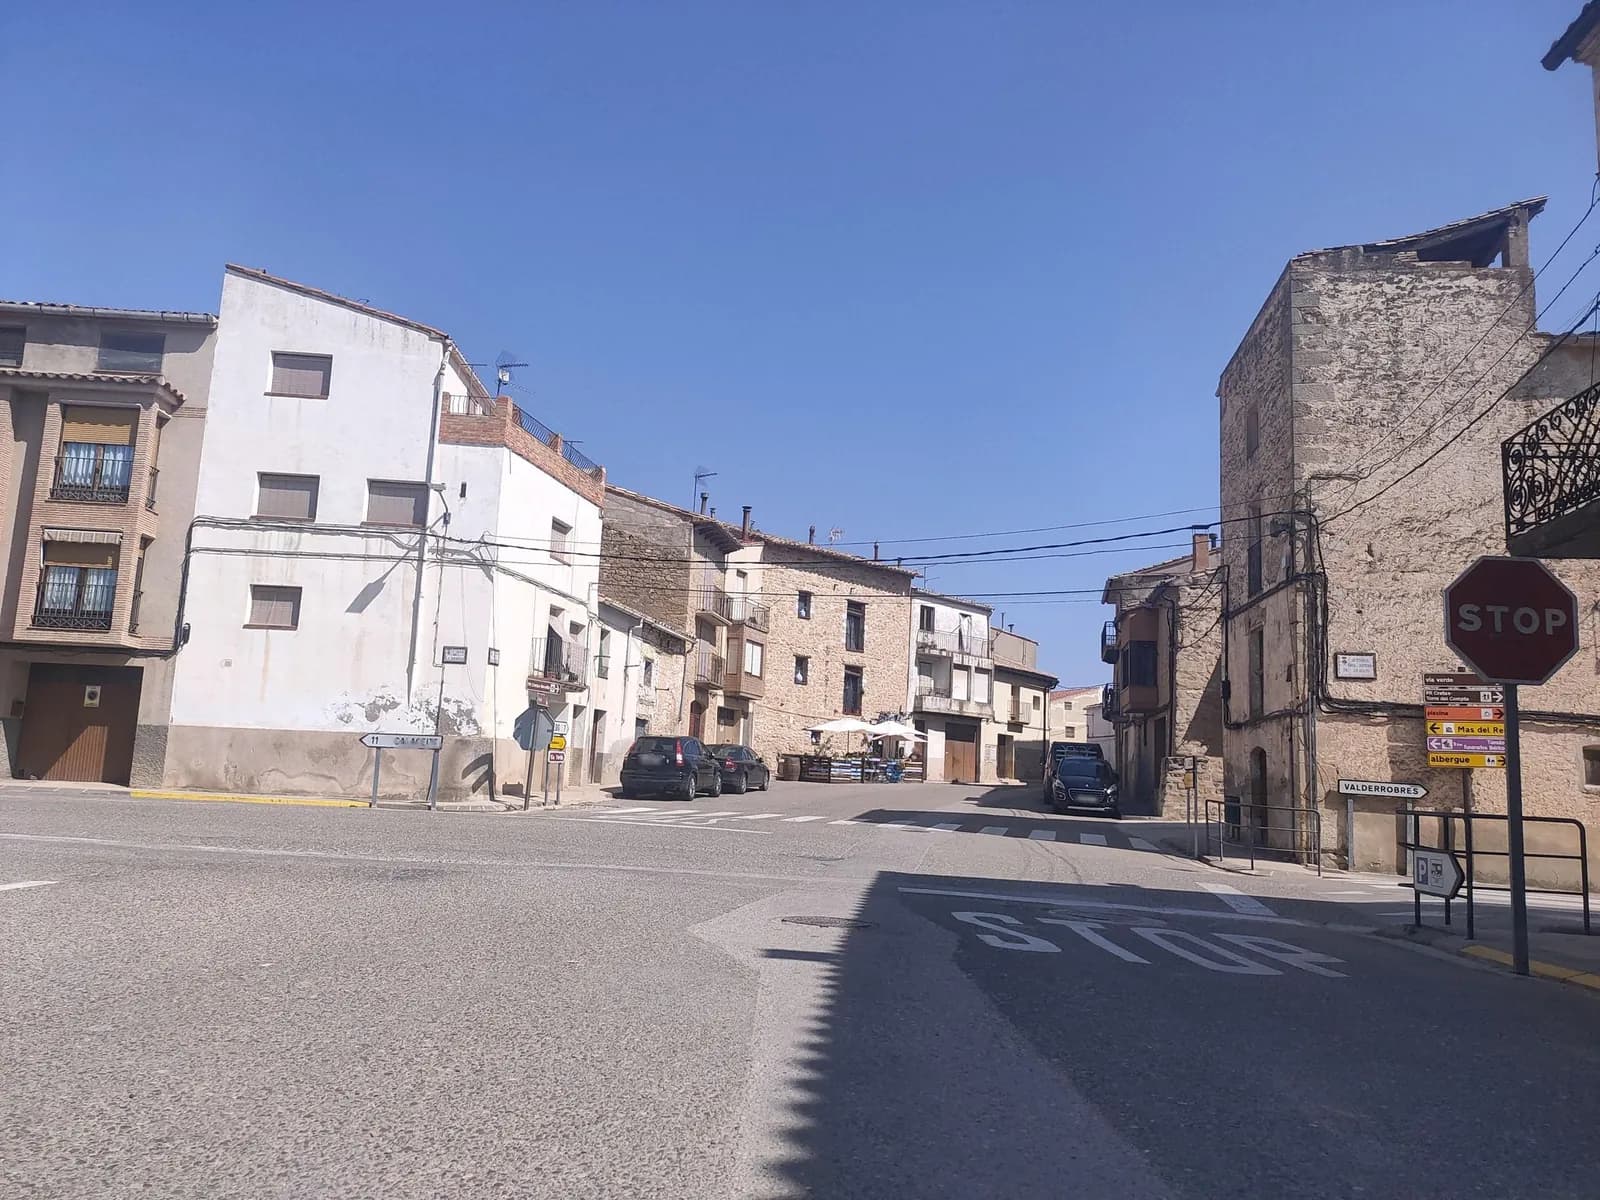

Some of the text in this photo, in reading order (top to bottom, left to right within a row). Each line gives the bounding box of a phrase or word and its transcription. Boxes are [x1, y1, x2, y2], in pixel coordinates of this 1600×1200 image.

[1458, 603, 1567, 636] STOP
[371, 736, 379, 744] 11
[1430, 756, 1470, 764] albergue
[1344, 783, 1419, 795] VALDERROBRES
[951, 911, 1351, 978] STOP
